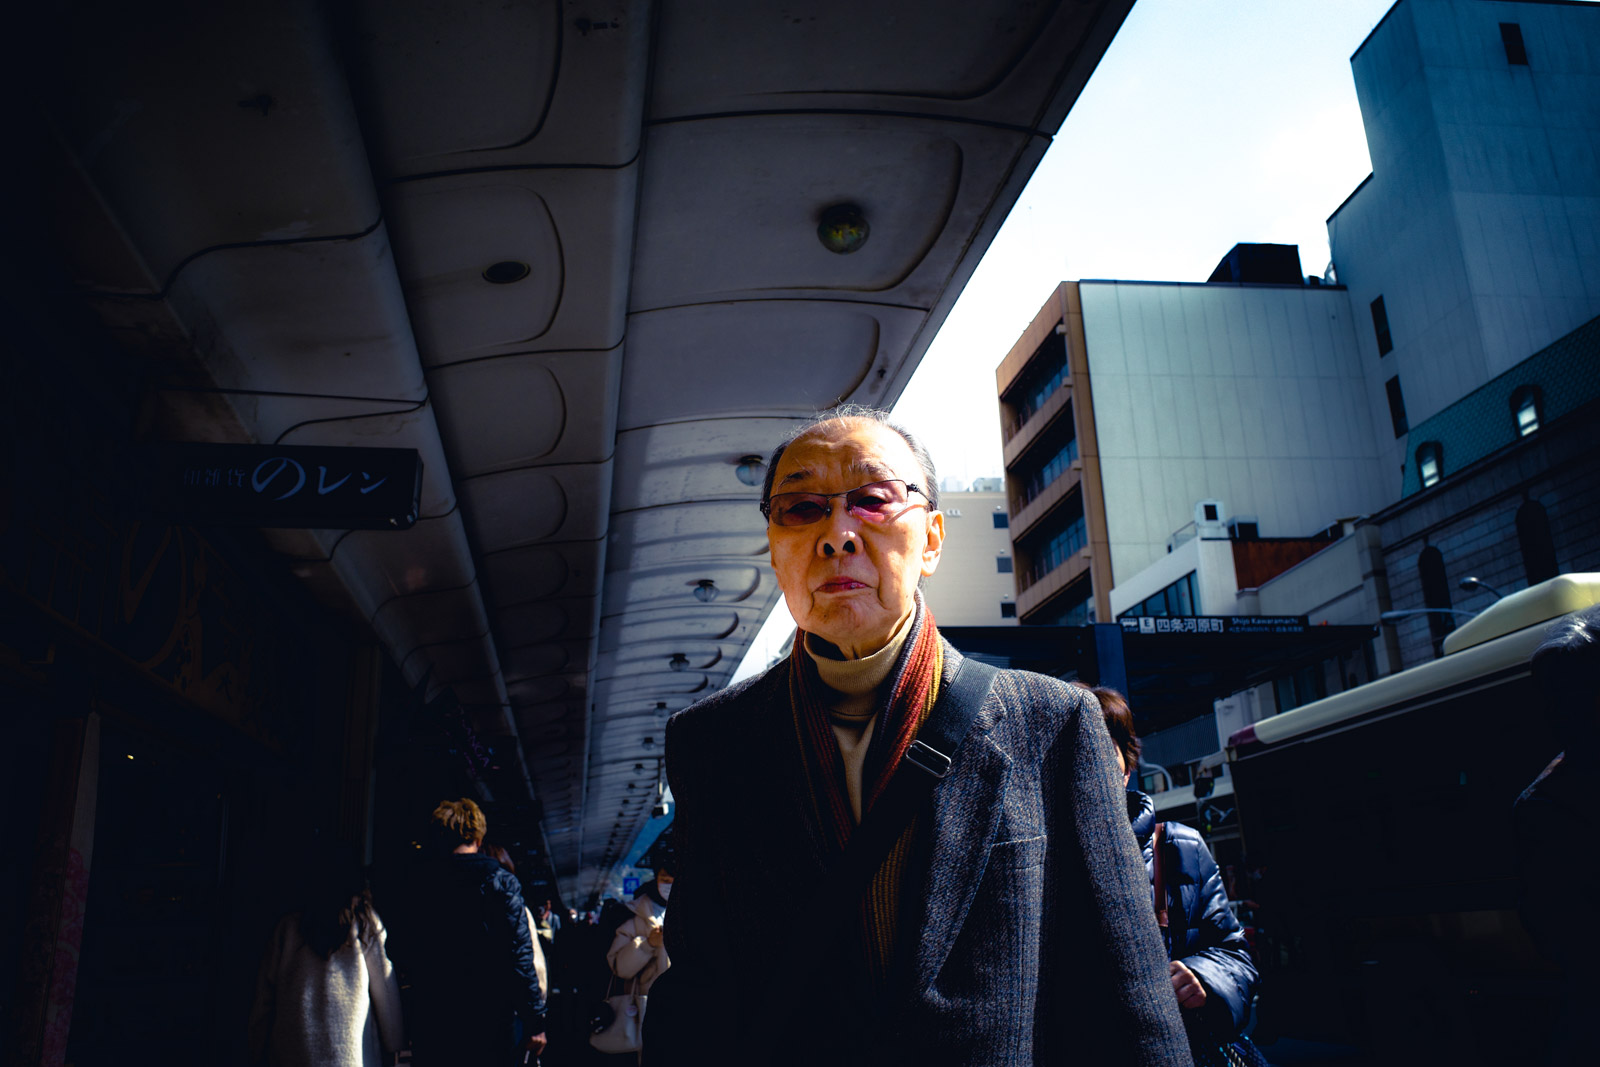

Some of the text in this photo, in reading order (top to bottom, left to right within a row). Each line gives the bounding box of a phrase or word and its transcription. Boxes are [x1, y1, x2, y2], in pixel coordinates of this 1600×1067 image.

[250, 456, 390, 502] のレン
[1156, 618, 1224, 633] 四条河原町
